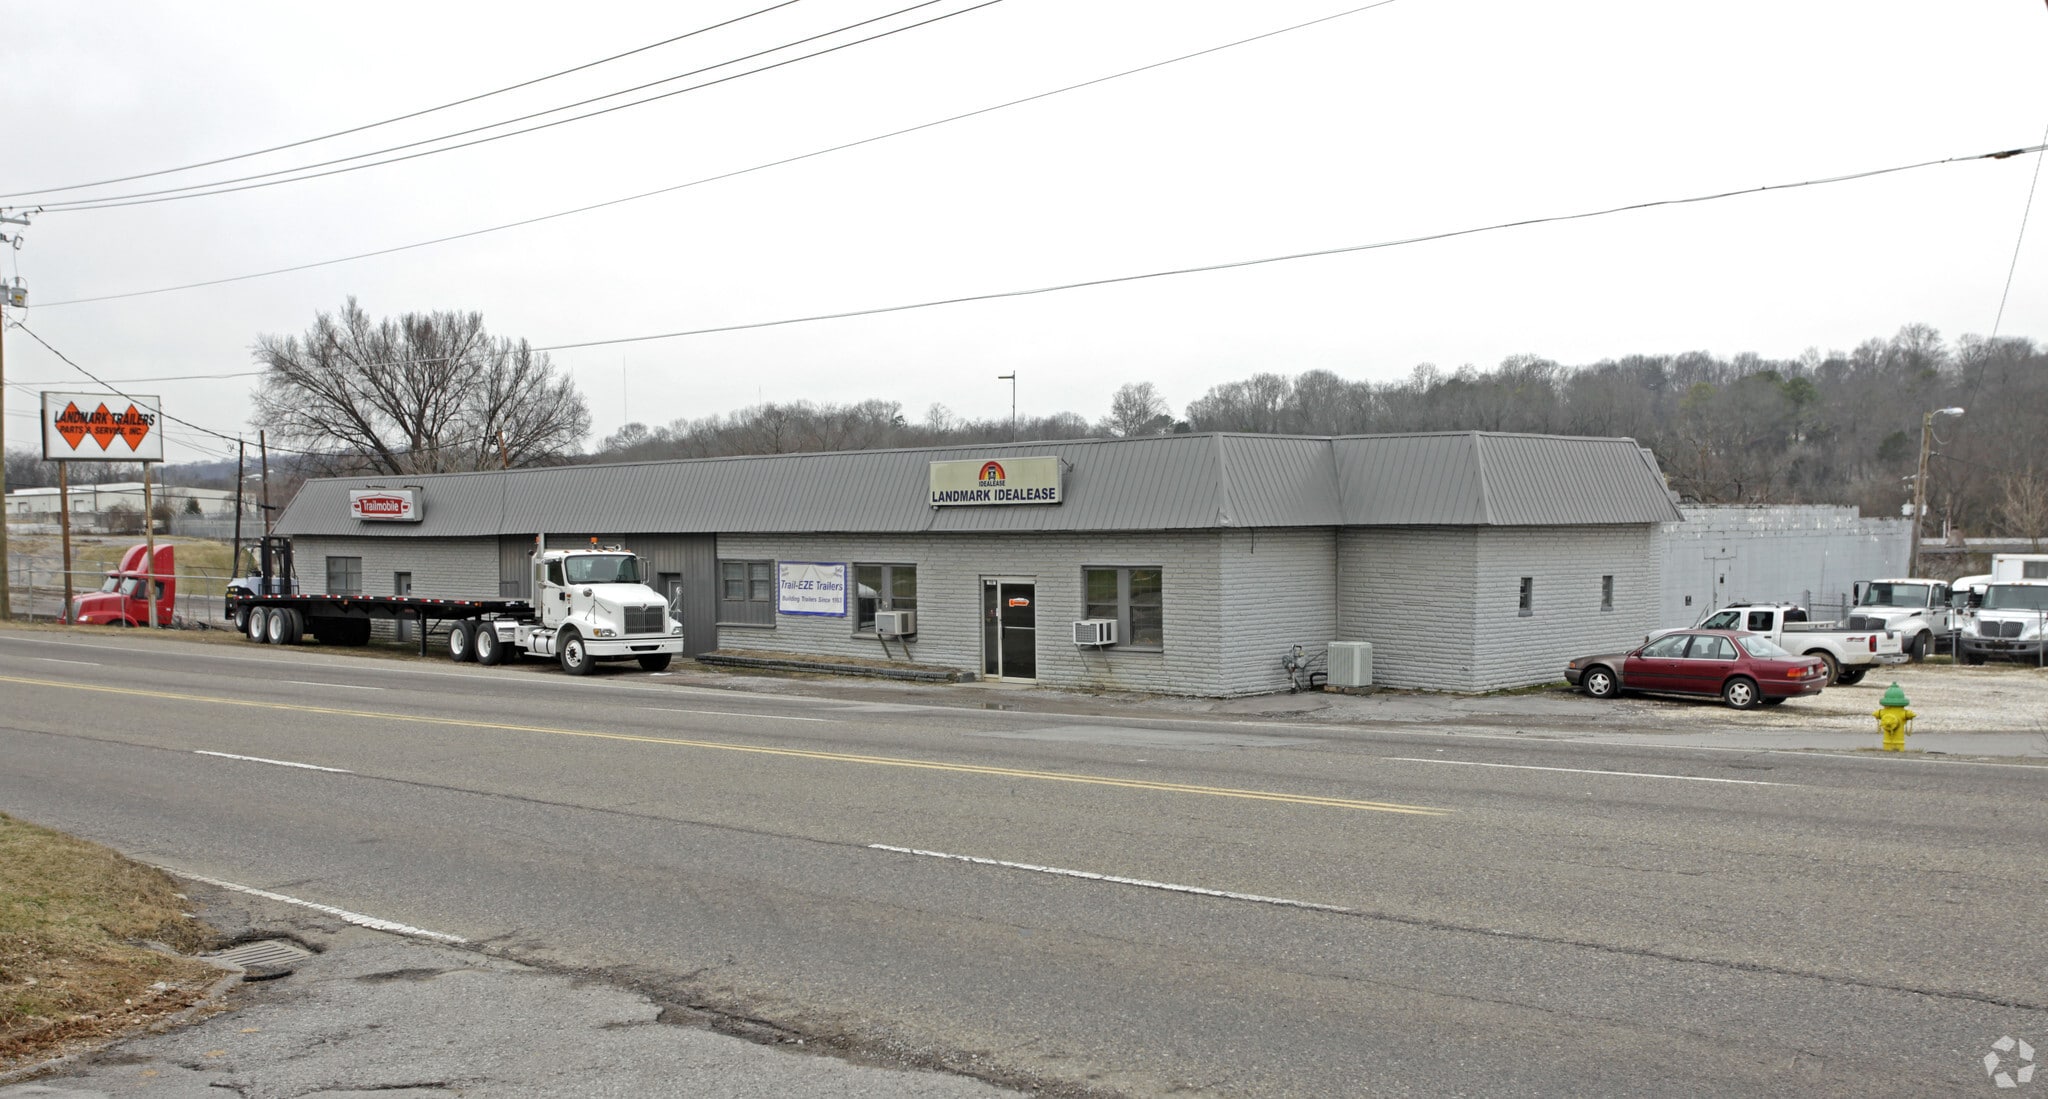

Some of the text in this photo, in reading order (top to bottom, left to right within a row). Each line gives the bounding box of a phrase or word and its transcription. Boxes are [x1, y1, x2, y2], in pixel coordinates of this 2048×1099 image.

[55, 411, 155, 426] LANDMARK TRAILERS
[61, 425, 83, 433] PARTS
[932, 488, 1056, 502] LANDMARK IDEALEASE
[363, 500, 399, 511] Trailmobile
[781, 580, 843, 591] Trail-EZE Trailers
